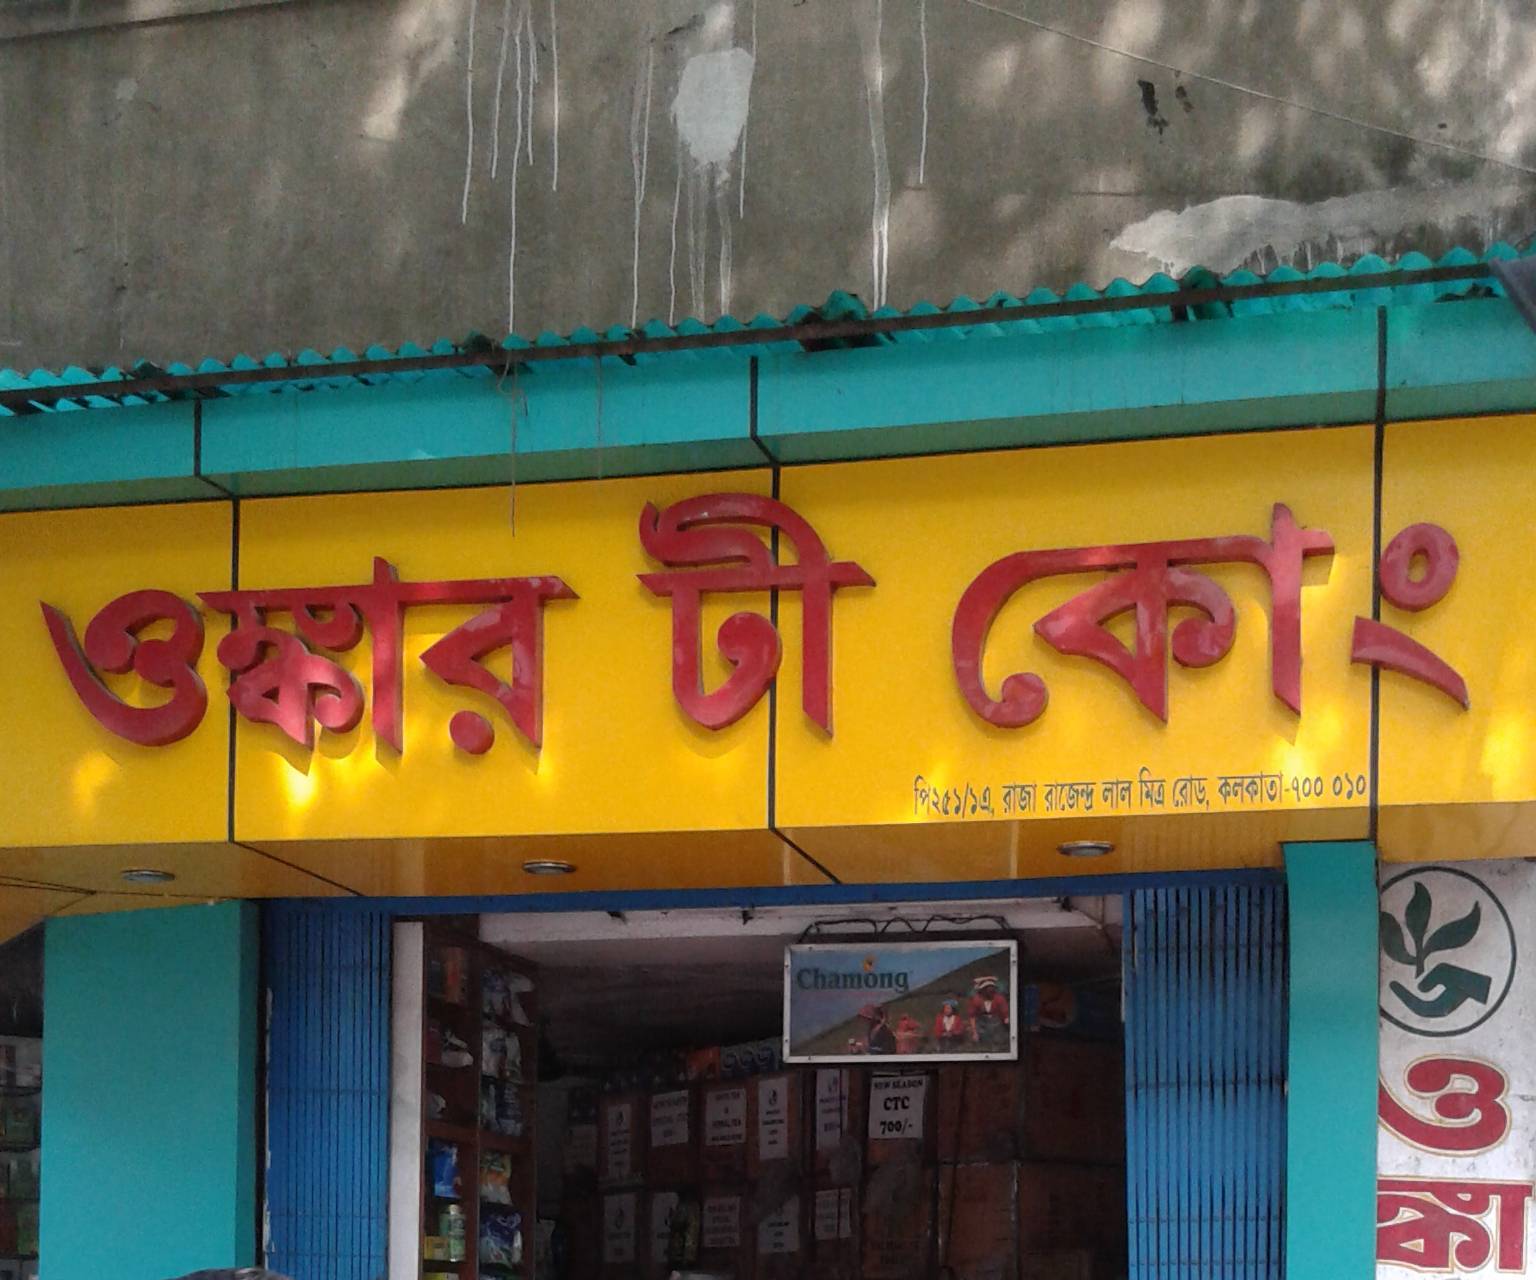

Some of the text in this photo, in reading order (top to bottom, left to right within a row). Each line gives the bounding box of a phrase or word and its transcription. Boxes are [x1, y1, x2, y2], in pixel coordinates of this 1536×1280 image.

[40, 492, 1469, 755] ওঙ্কার টী কোং
[1002, 782, 1037, 814] রাজা
[1044, 782, 1096, 811] রাজেন্দ্র
[1102, 779, 1133, 809] লাল
[1138, 766, 1166, 808] মিত্র
[1172, 774, 1209, 810] রোড,
[797, 968, 908, 993] Chamong
[884, 1096, 910, 1110] CTC
[880, 1118, 912, 1134] 700/-
